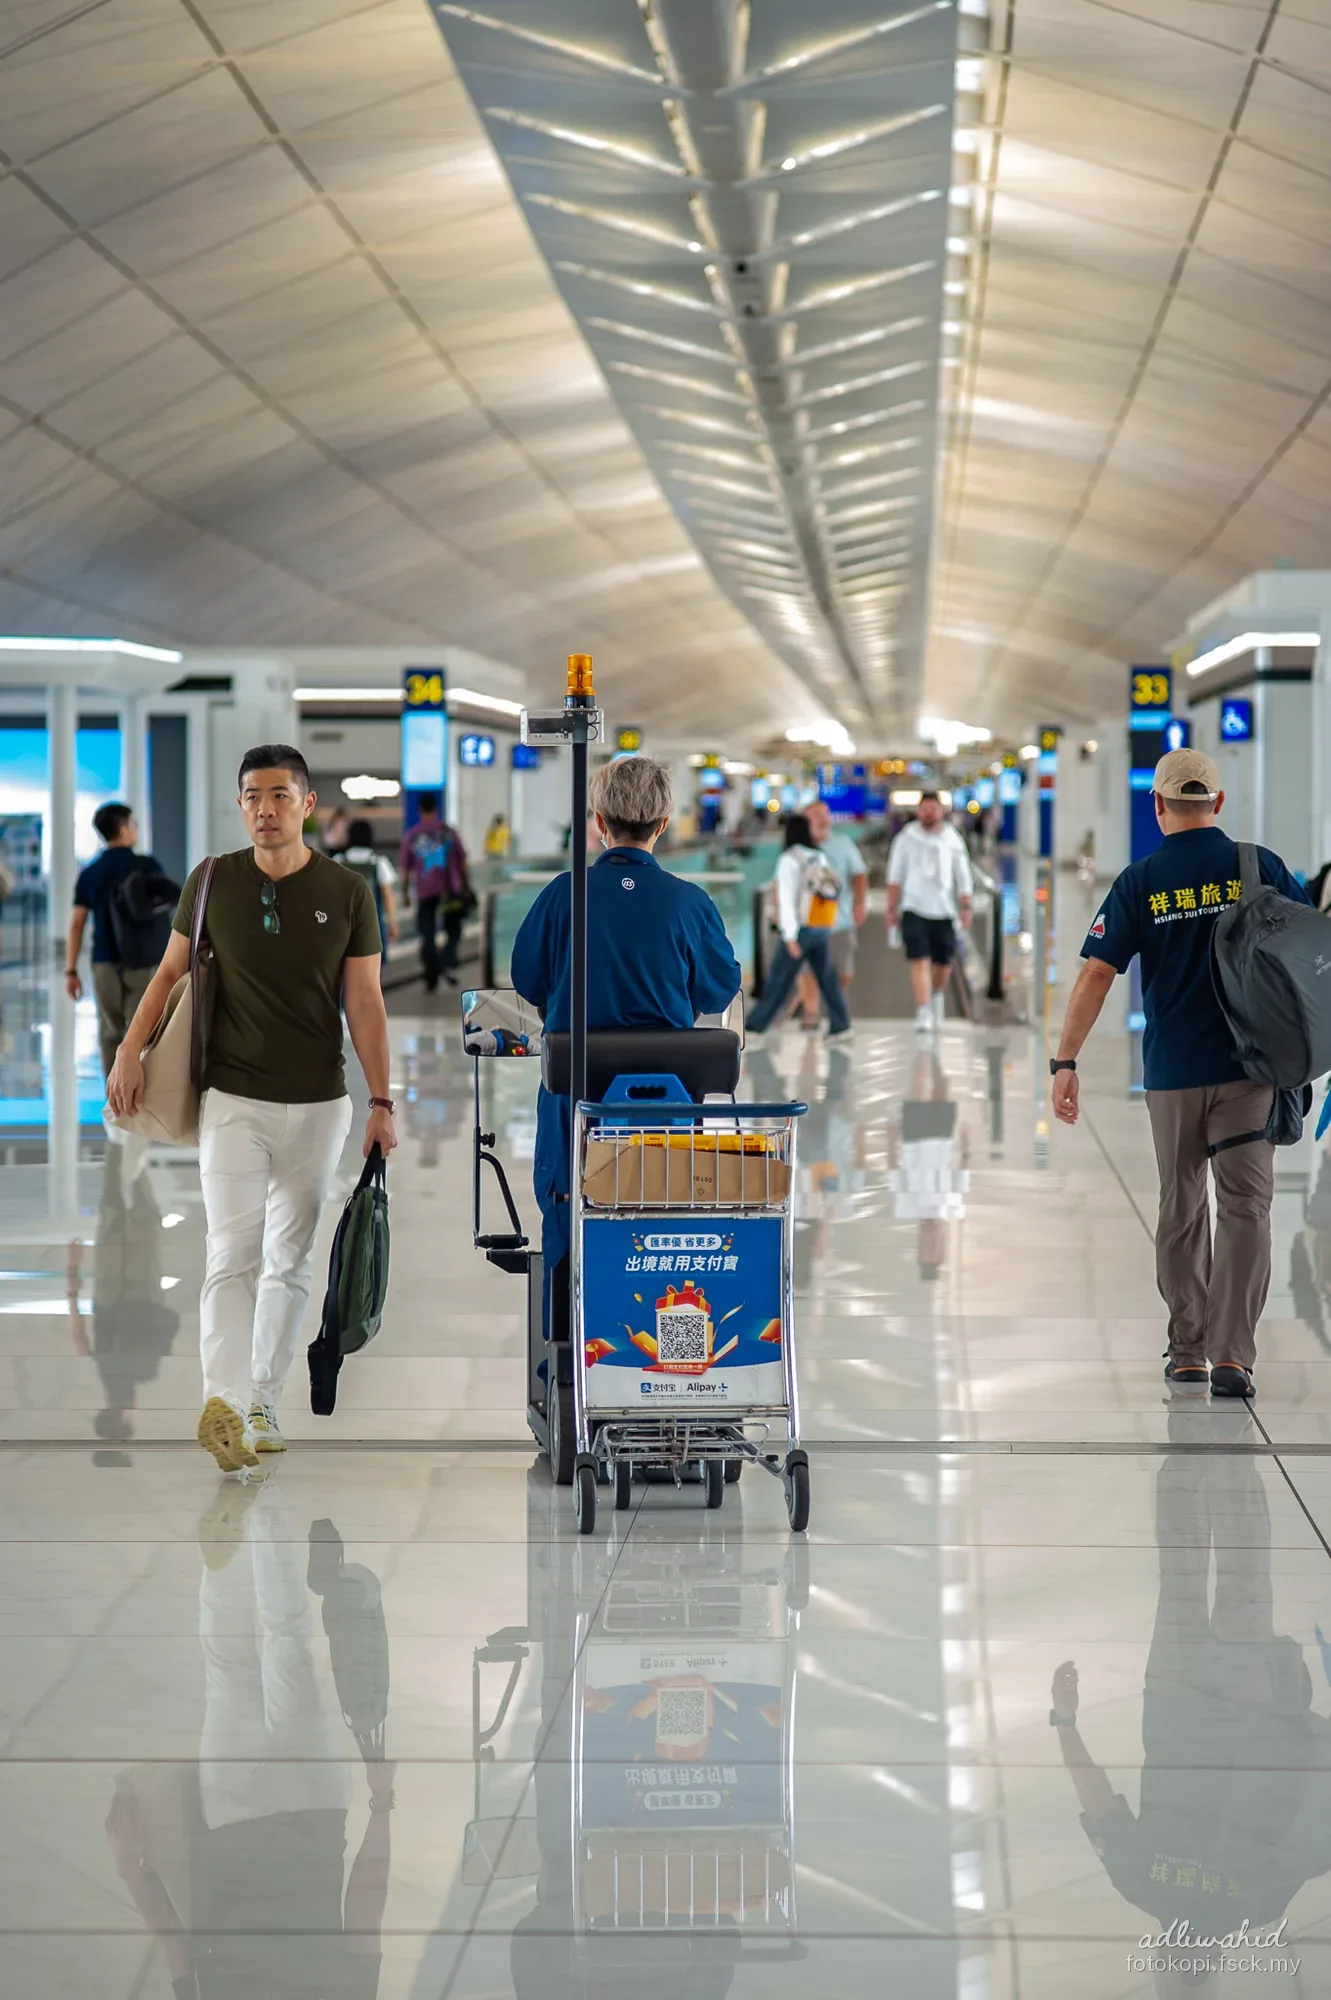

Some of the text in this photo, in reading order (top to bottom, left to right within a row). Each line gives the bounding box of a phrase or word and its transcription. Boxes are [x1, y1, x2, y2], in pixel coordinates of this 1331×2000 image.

[406, 674, 443, 705] 34
[1132, 674, 1169, 705] 33
[1154, 912, 1183, 924] HSIANG
[1198, 906, 1219, 916] TOUR
[625, 1255, 739, 1272] 出境就用支付寶
[653, 1383, 676, 1392] 支付宝
